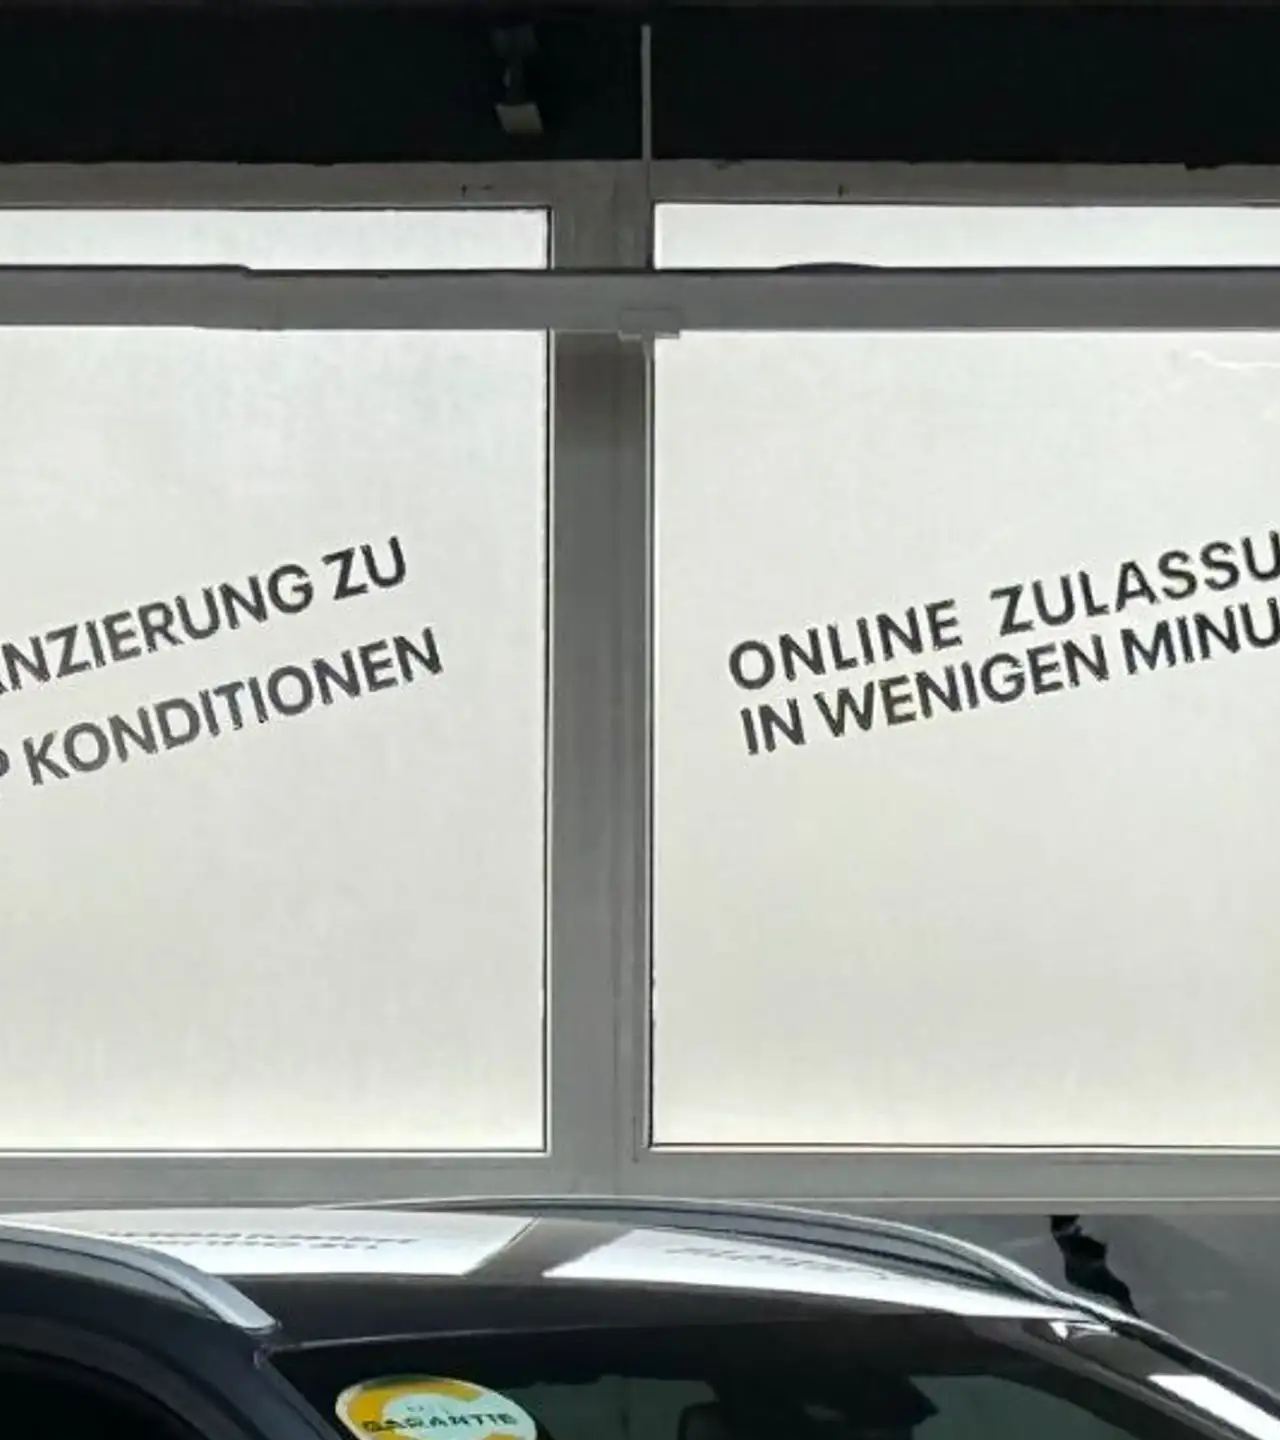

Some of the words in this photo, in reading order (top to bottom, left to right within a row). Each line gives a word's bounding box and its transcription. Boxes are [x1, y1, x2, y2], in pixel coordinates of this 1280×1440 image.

[321, 535, 407, 602] ZU
[728, 598, 964, 691] ONLINE
[22, 626, 444, 787] KONDITIONEN
[739, 697, 806, 756] IN
[812, 633, 1110, 739] WENIGEN
[362, 1412, 518, 1433] GARANTIE
